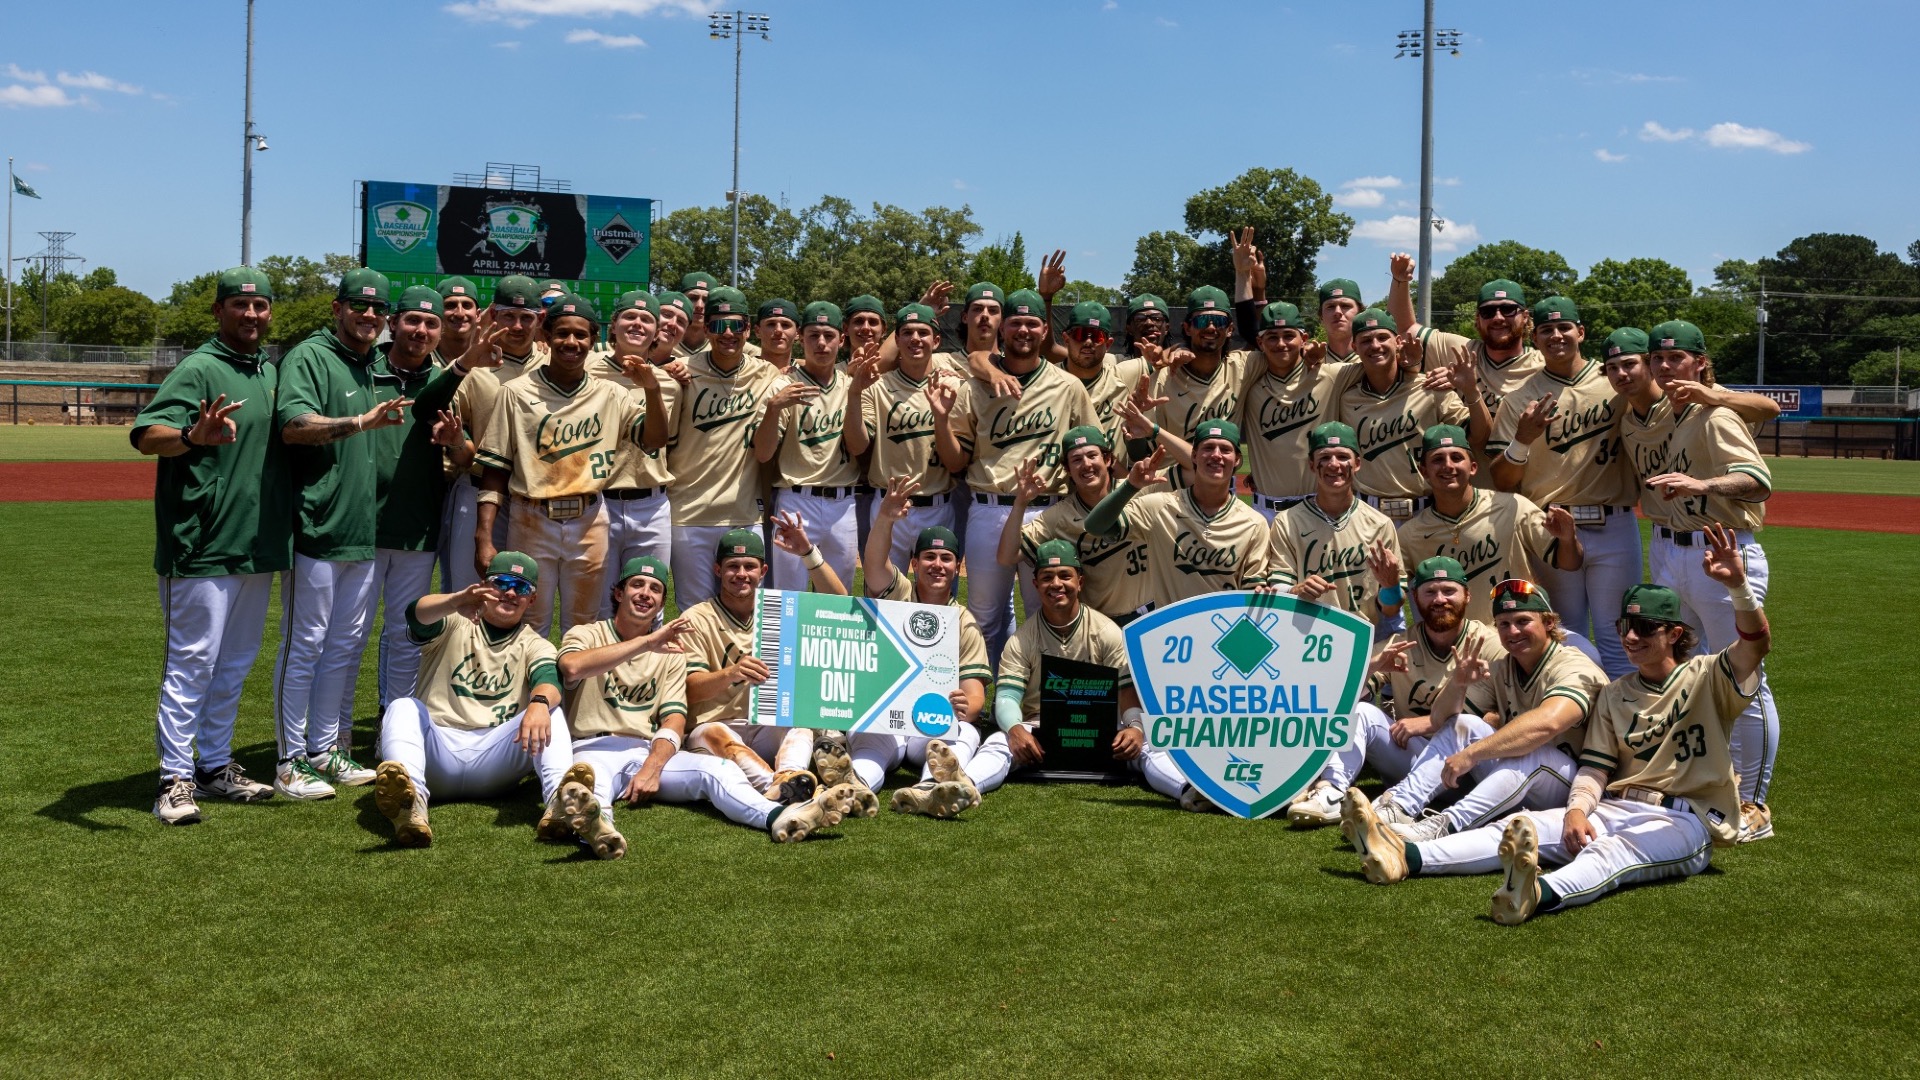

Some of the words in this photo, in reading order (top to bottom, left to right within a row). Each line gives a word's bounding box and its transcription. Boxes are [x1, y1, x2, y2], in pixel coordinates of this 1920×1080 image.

[377, 229, 427, 238] CHAMPIONSHIPS
[383, 222, 421, 231] BASEBALL
[490, 233, 537, 241] CHAMPIONSHIPS
[495, 226, 531, 234] BASEBALL
[592, 228, 644, 239] Trustmark
[472, 259, 501, 269] APRIL
[503, 261, 542, 271] 29-MAY
[544, 263, 550, 271] 2
[691, 387, 758, 424] Lions
[887, 401, 935, 433] Lion
[1259, 392, 1320, 429] Lions
[536, 412, 604, 452] Lions
[798, 405, 845, 437] Lion
[989, 406, 1057, 441] Lions
[1356, 409, 1421, 450] Lions
[1545, 398, 1616, 446] Lions
[589, 449, 616, 480] 25
[1127, 544, 1148, 577] 35
[1173, 531, 1241, 569] Lions
[1303, 539, 1369, 579] Lions
[801, 624, 833, 638] TICKET
[836, 627, 877, 640] PUNCHED
[784, 646, 793, 654] 12
[800, 637, 878, 673] MOVING
[1162, 635, 1193, 664] 20
[1301, 634, 1333, 663] 26
[451, 652, 515, 692] Lions
[820, 670, 855, 703] ON!
[1045, 678, 1071, 690] CCS
[1071, 678, 1114, 687] COLLEGIATE
[1165, 684, 1329, 714] BASEBALL
[889, 710, 905, 720] NEXT
[889, 719, 906, 730] STOP:
[916, 711, 952, 727] NCAA
[1070, 713, 1088, 724] 2026
[1057, 728, 1099, 738] TOURNAMENT
[1061, 738, 1095, 748] CHAMPION
[1151, 716, 1350, 748] CHAMPIONS
[1671, 723, 1708, 763] 33
[1223, 764, 1264, 782] CCS
